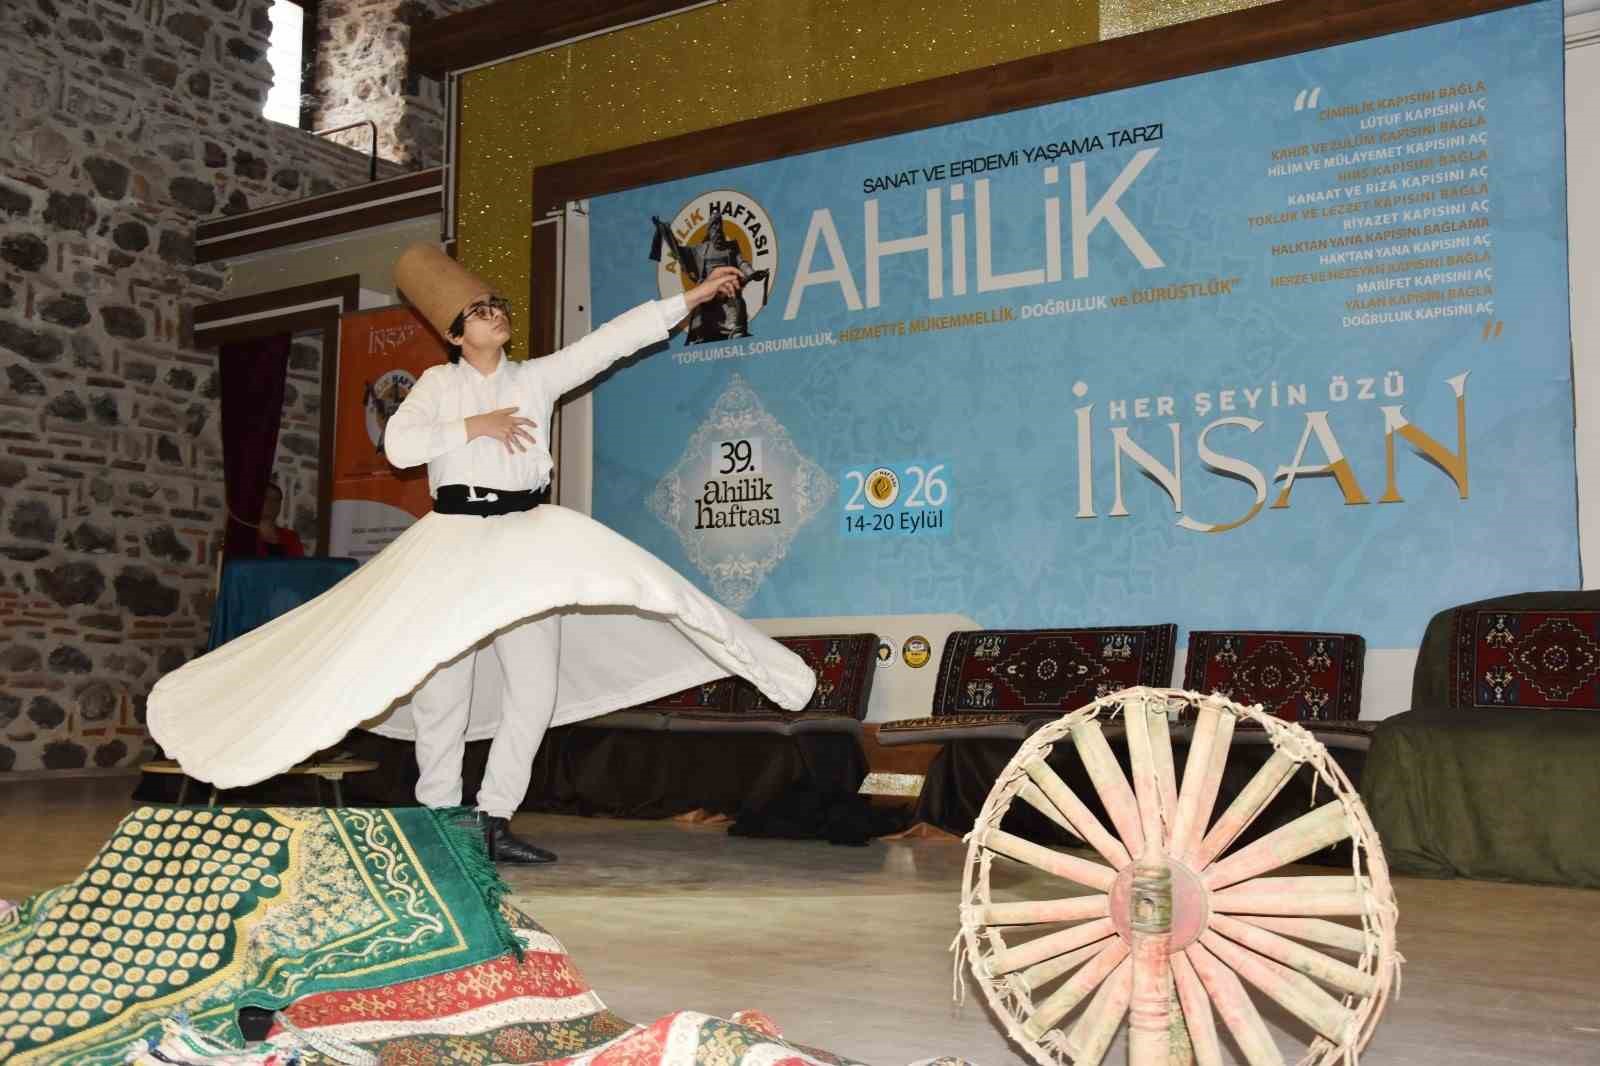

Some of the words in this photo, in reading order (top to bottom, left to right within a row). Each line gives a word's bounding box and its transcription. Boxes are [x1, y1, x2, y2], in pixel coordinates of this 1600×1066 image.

[1376, 89, 1435, 110] KAPISINI
[1360, 111, 1401, 130] LÜTUF
[1405, 102, 1464, 122] KAPISINI
[1468, 98, 1488, 115] AÇ
[1380, 124, 1435, 144] KAPISINI
[863, 169, 918, 194] SANAT
[922, 165, 946, 182] VE
[1022, 135, 1104, 164] YAŞAMA
[1107, 123, 1164, 149] TARZI
[1305, 158, 1320, 171] VE
[1324, 144, 1402, 168] MÜLAYEMET
[1406, 136, 1465, 155] KAPISINI
[1469, 132, 1488, 148] AÇ
[1288, 187, 1341, 206] KANAAT
[1344, 184, 1361, 198] VE
[1402, 169, 1464, 189] KAPISINI
[1469, 166, 1488, 182] AÇ
[1375, 191, 1435, 210] KAPISINI
[1403, 203, 1466, 222] KAPISINI
[1470, 200, 1489, 216] AÇ
[708, 200, 769, 257] HAFTASI
[1328, 234, 1362, 248] YANA
[1365, 226, 1420, 243] KAPISINI
[1375, 244, 1409, 258] YANA
[1413, 236, 1470, 254] KAPISINI
[1473, 234, 1491, 250] AÇ
[1356, 275, 1411, 293] MARİFET
[1414, 270, 1471, 287] KAPISINI
[1474, 268, 1492, 284] AÇ
[1020, 294, 1107, 319] DOĞRULUK
[1110, 294, 1128, 307] ve
[1342, 309, 1413, 327] DOĞRULUK
[1415, 304, 1472, 320] KAPISINI
[1475, 302, 1494, 317] AÇ
[1109, 397, 1175, 420] HER
[1194, 381, 1307, 417] ŞEYİN
[1329, 371, 1404, 402] ÖZÜ
[720, 440, 755, 474] 39.
[1072, 370, 1472, 533] İNSAN
[703, 478, 773, 505] ahilik
[694, 499, 781, 530] haftası
[846, 514, 894, 533] 14-20
[900, 509, 944, 534] Eylül
